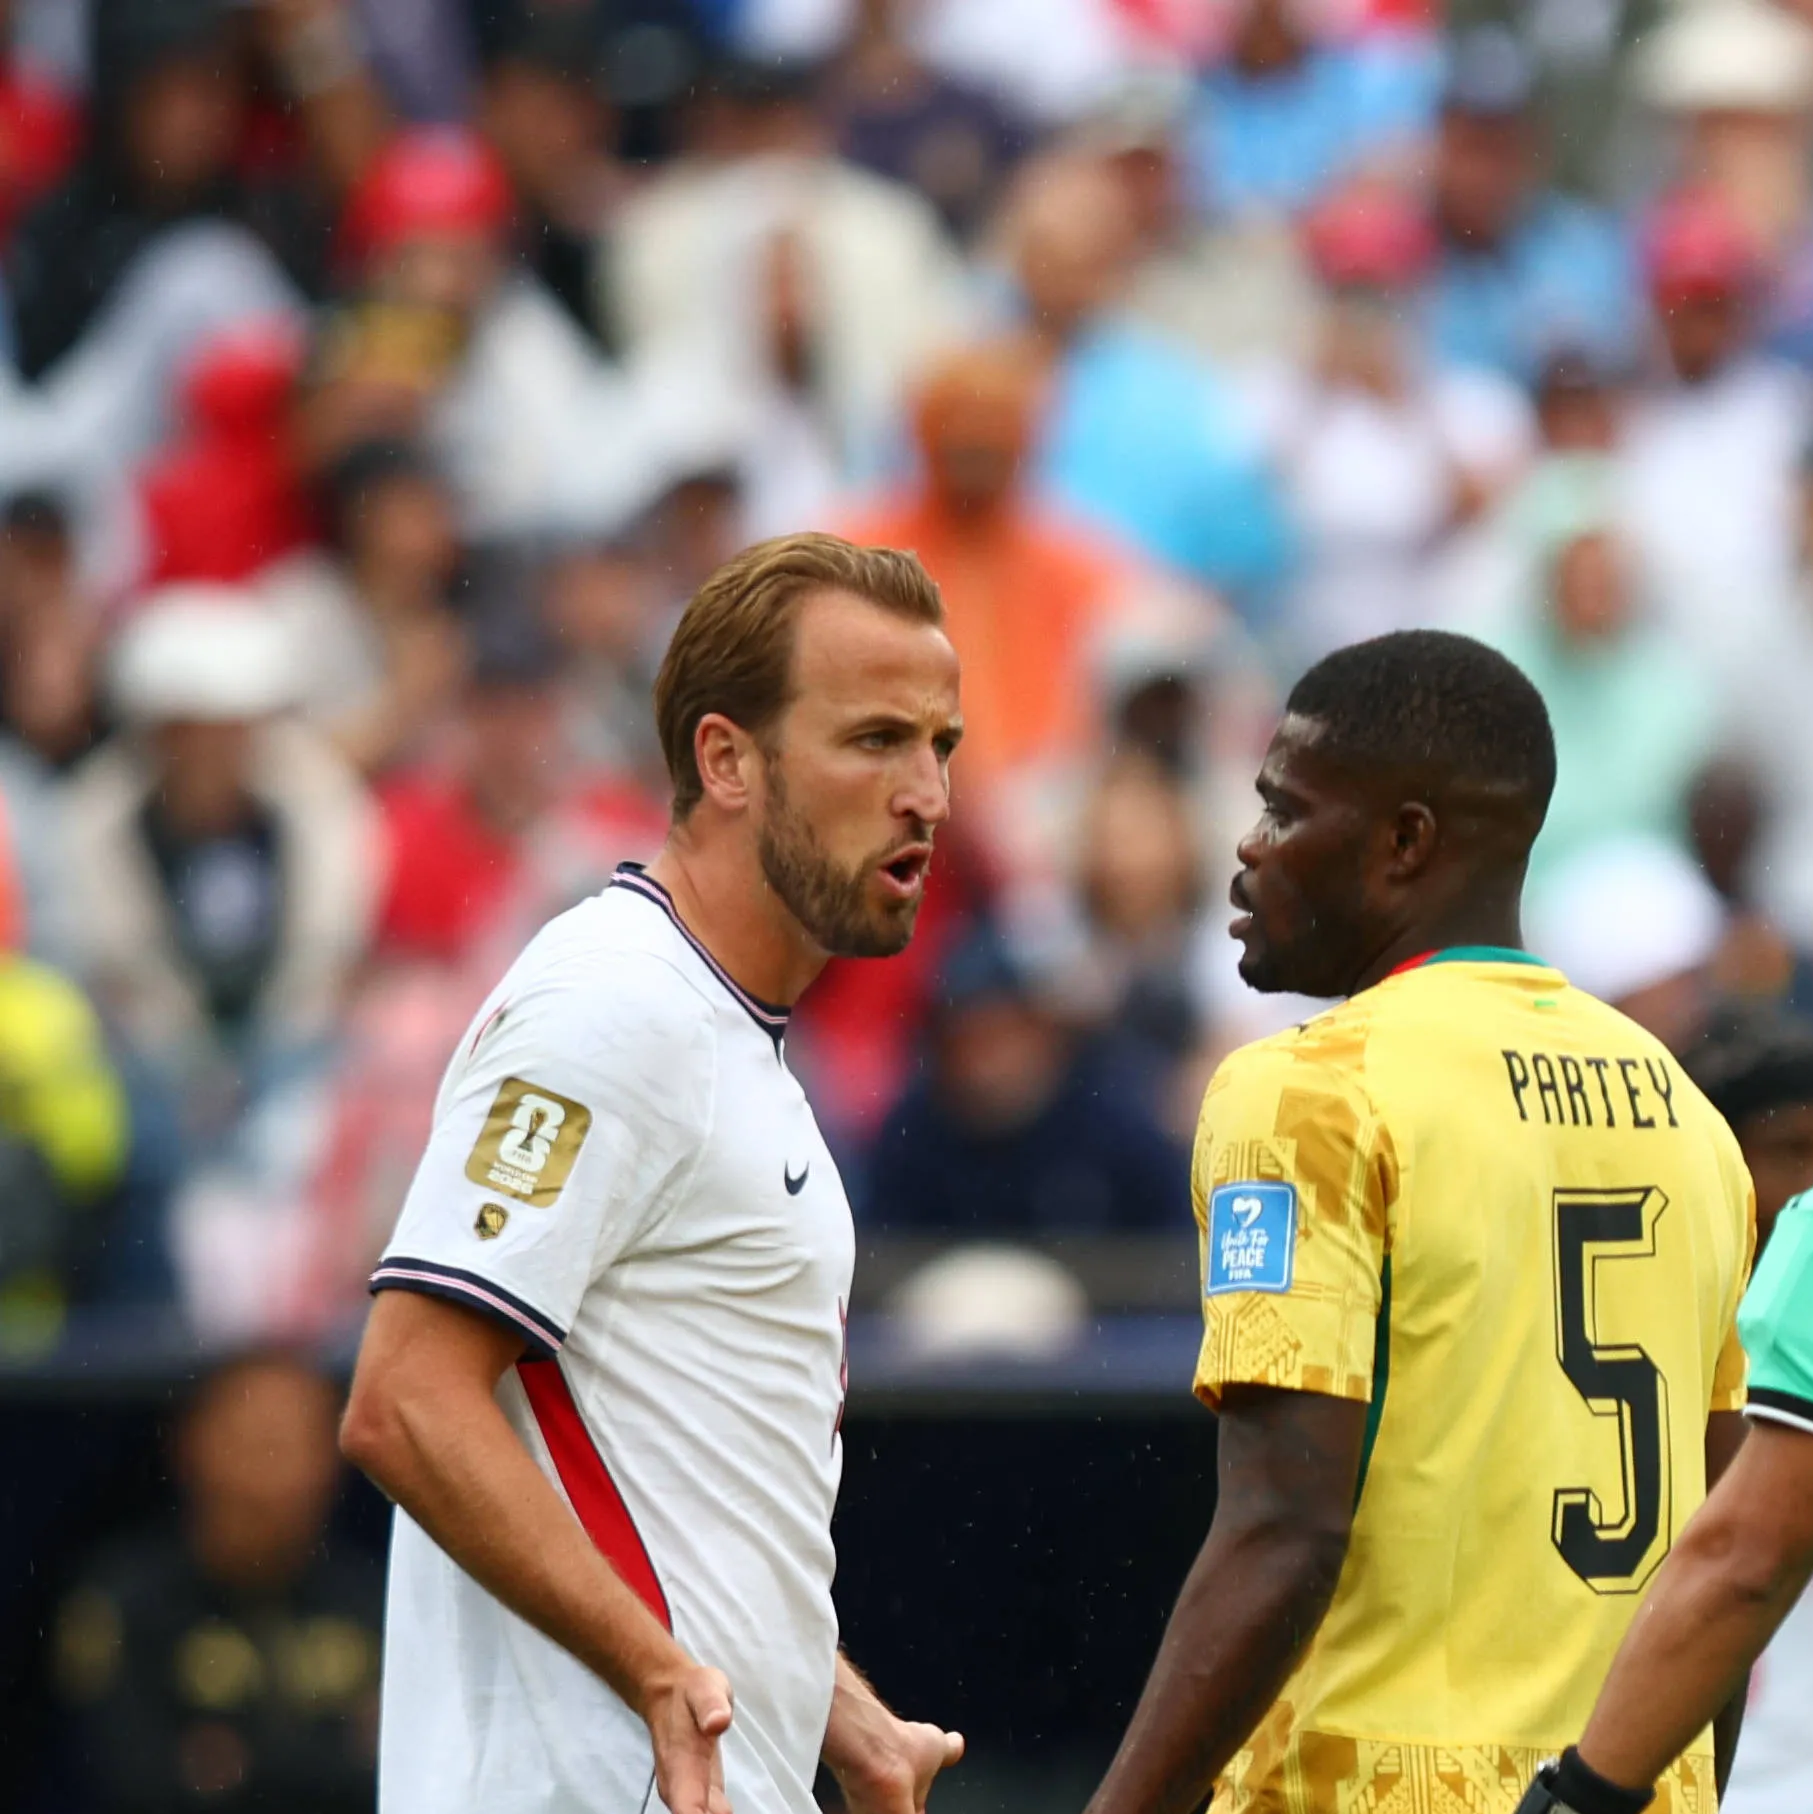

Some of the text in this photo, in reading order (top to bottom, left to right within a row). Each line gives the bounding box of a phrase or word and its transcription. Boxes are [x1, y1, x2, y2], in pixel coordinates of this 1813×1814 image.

[1501, 1049, 1680, 1129] PARTEY
[1222, 1247, 1265, 1270] PEACE
[1228, 1268, 1253, 1281] FIFA
[1551, 1185, 1671, 1595] 5
